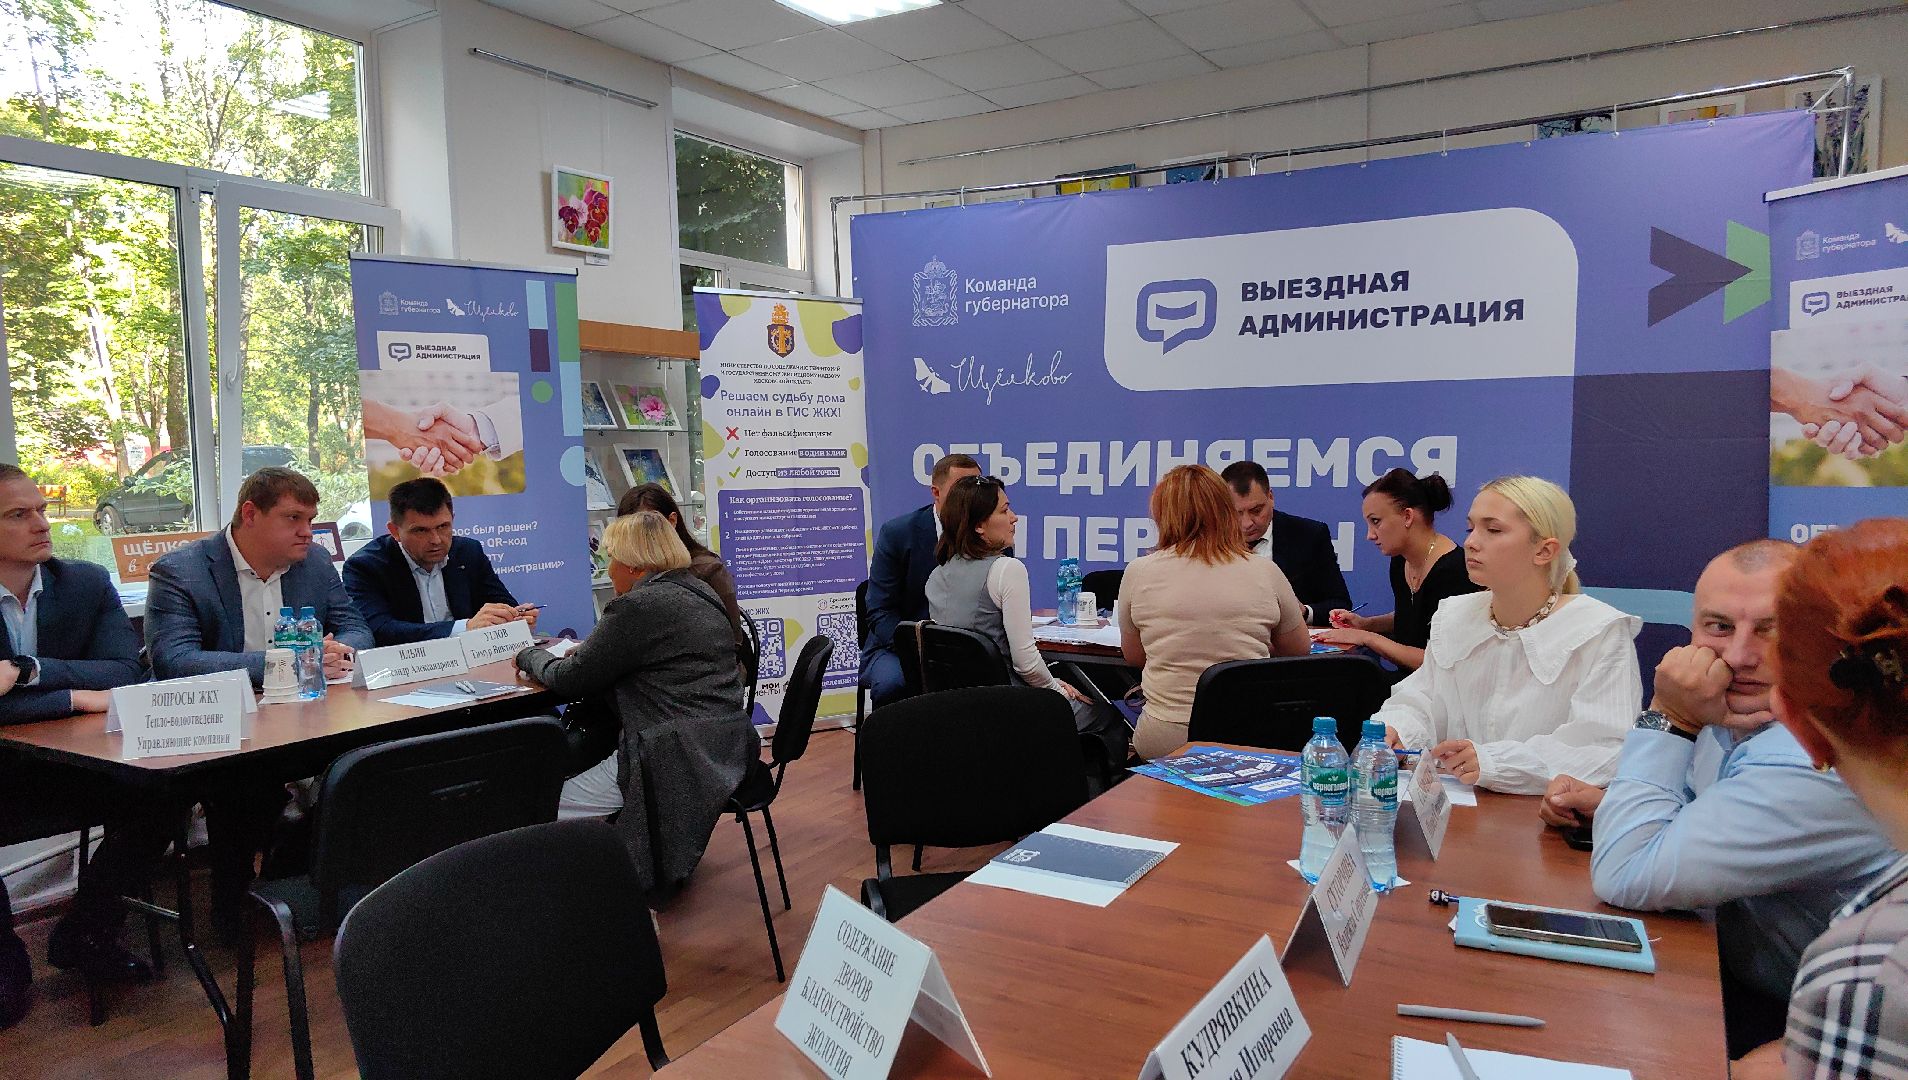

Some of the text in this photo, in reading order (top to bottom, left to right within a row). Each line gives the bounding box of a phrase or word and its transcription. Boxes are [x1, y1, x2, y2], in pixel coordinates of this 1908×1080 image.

[1822, 233, 1860, 244] Команда
[1822, 240, 1876, 253] губернатора
[965, 276, 1037, 294] Команда
[1241, 270, 1410, 302] ВЫЕЗДНАЯ
[1836, 285, 1893, 299] ВЫЕЗДНАЯ
[400, 299, 429, 307] Команда
[965, 294, 1069, 316] губернатора
[1836, 295, 1908, 309] АДМИНИСТРА
[1238, 298, 1525, 337] АДМИНИСТРАЦИЯ
[415, 344, 457, 352] ВЫЕЗДНАЯ
[415, 352, 481, 360] АДМИНИСТРАЦИЯ
[720, 389, 846, 404] Решаем судьбу дома
[726, 406, 772, 417] онлайн
[775, 408, 783, 417] в
[787, 406, 809, 417] ГИС
[744, 429, 761, 437] Нет
[744, 449, 797, 457] Голосование
[804, 450, 826, 458] один
[745, 468, 840, 478] Доступ из любой точки
[729, 496, 745, 504] Как
[803, 493, 853, 503] голосование?
[473, 524, 495, 535] был
[498, 521, 538, 535] решен?
[487, 537, 527, 548] QR-код
[151, 689, 221, 708] ВОПРОСЫ ЖКХ
[145, 712, 225, 729] Тепло-водоотведение
[137, 733, 230, 753] Управляющие компании
[837, 919, 898, 978] СОДЕРЖАНИЕ
[833, 960, 874, 1003] ДВОРОВ
[799, 976, 885, 1059] БЛАГОУСТРОЙСТВО
[1180, 966, 1272, 1080] КУДРЯВКИНА
[1238, 1006, 1294, 1079] Игоревна
[803, 1022, 853, 1079] ЭКОЛОГИЯ
